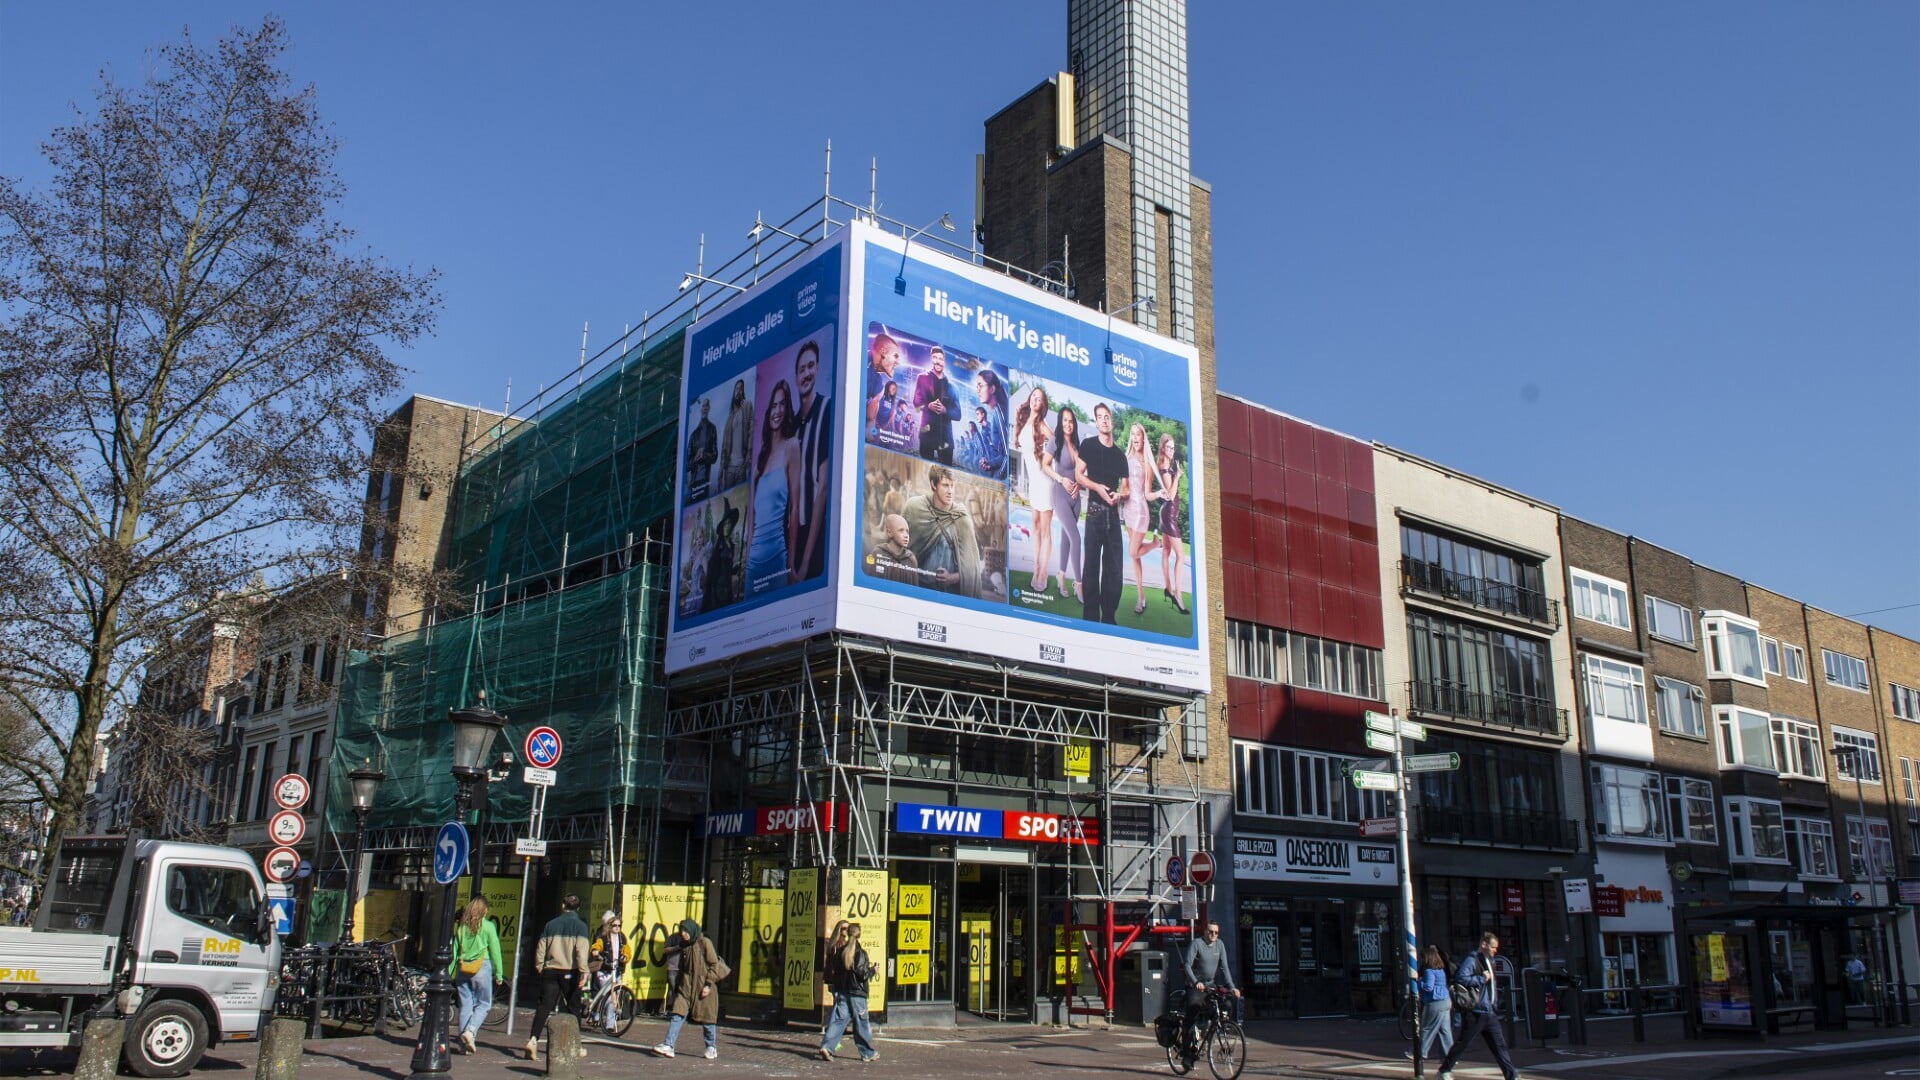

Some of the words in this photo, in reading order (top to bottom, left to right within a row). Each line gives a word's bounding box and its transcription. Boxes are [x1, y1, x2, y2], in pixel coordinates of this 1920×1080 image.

[798, 281, 818, 299] prime
[797, 293, 817, 311] video
[924, 286, 974, 326] Hier
[977, 306, 1017, 342] kijk
[1017, 320, 1039, 349] je
[1042, 332, 1090, 366] alles
[702, 343, 724, 367] Hier
[725, 330, 745, 354] kijk
[745, 325, 756, 347] je
[757, 309, 784, 337] alles
[1113, 352, 1137, 369] prime
[1113, 364, 1137, 381] video
[922, 622, 943, 633] TWIN
[922, 632, 943, 641] SPORT
[1043, 645, 1061, 655] TWIN
[1043, 653, 1061, 662] SPORT
[707, 813, 743, 834] TWIN
[766, 807, 815, 831] SPORT
[919, 808, 981, 833] TWIN
[1018, 815, 1085, 840] SPORT
[1236, 839, 1252, 852] GRILL
[1258, 841, 1274, 854] PIZZA
[1286, 838, 1350, 869] OASEBOOM
[1361, 849, 1371, 860] DAY
[1376, 850, 1390, 861] NIGHT
[790, 890, 813, 918] 20%
[846, 891, 882, 919] 20%
[905, 893, 924, 908] 20%
[904, 928, 923, 943] 20%
[1256, 931, 1275, 946] OASE
[204, 937, 241, 953] RvR
[0, 968, 40, 983] P.NL
[787, 959, 810, 987] 20%
[902, 962, 922, 978] 20%
